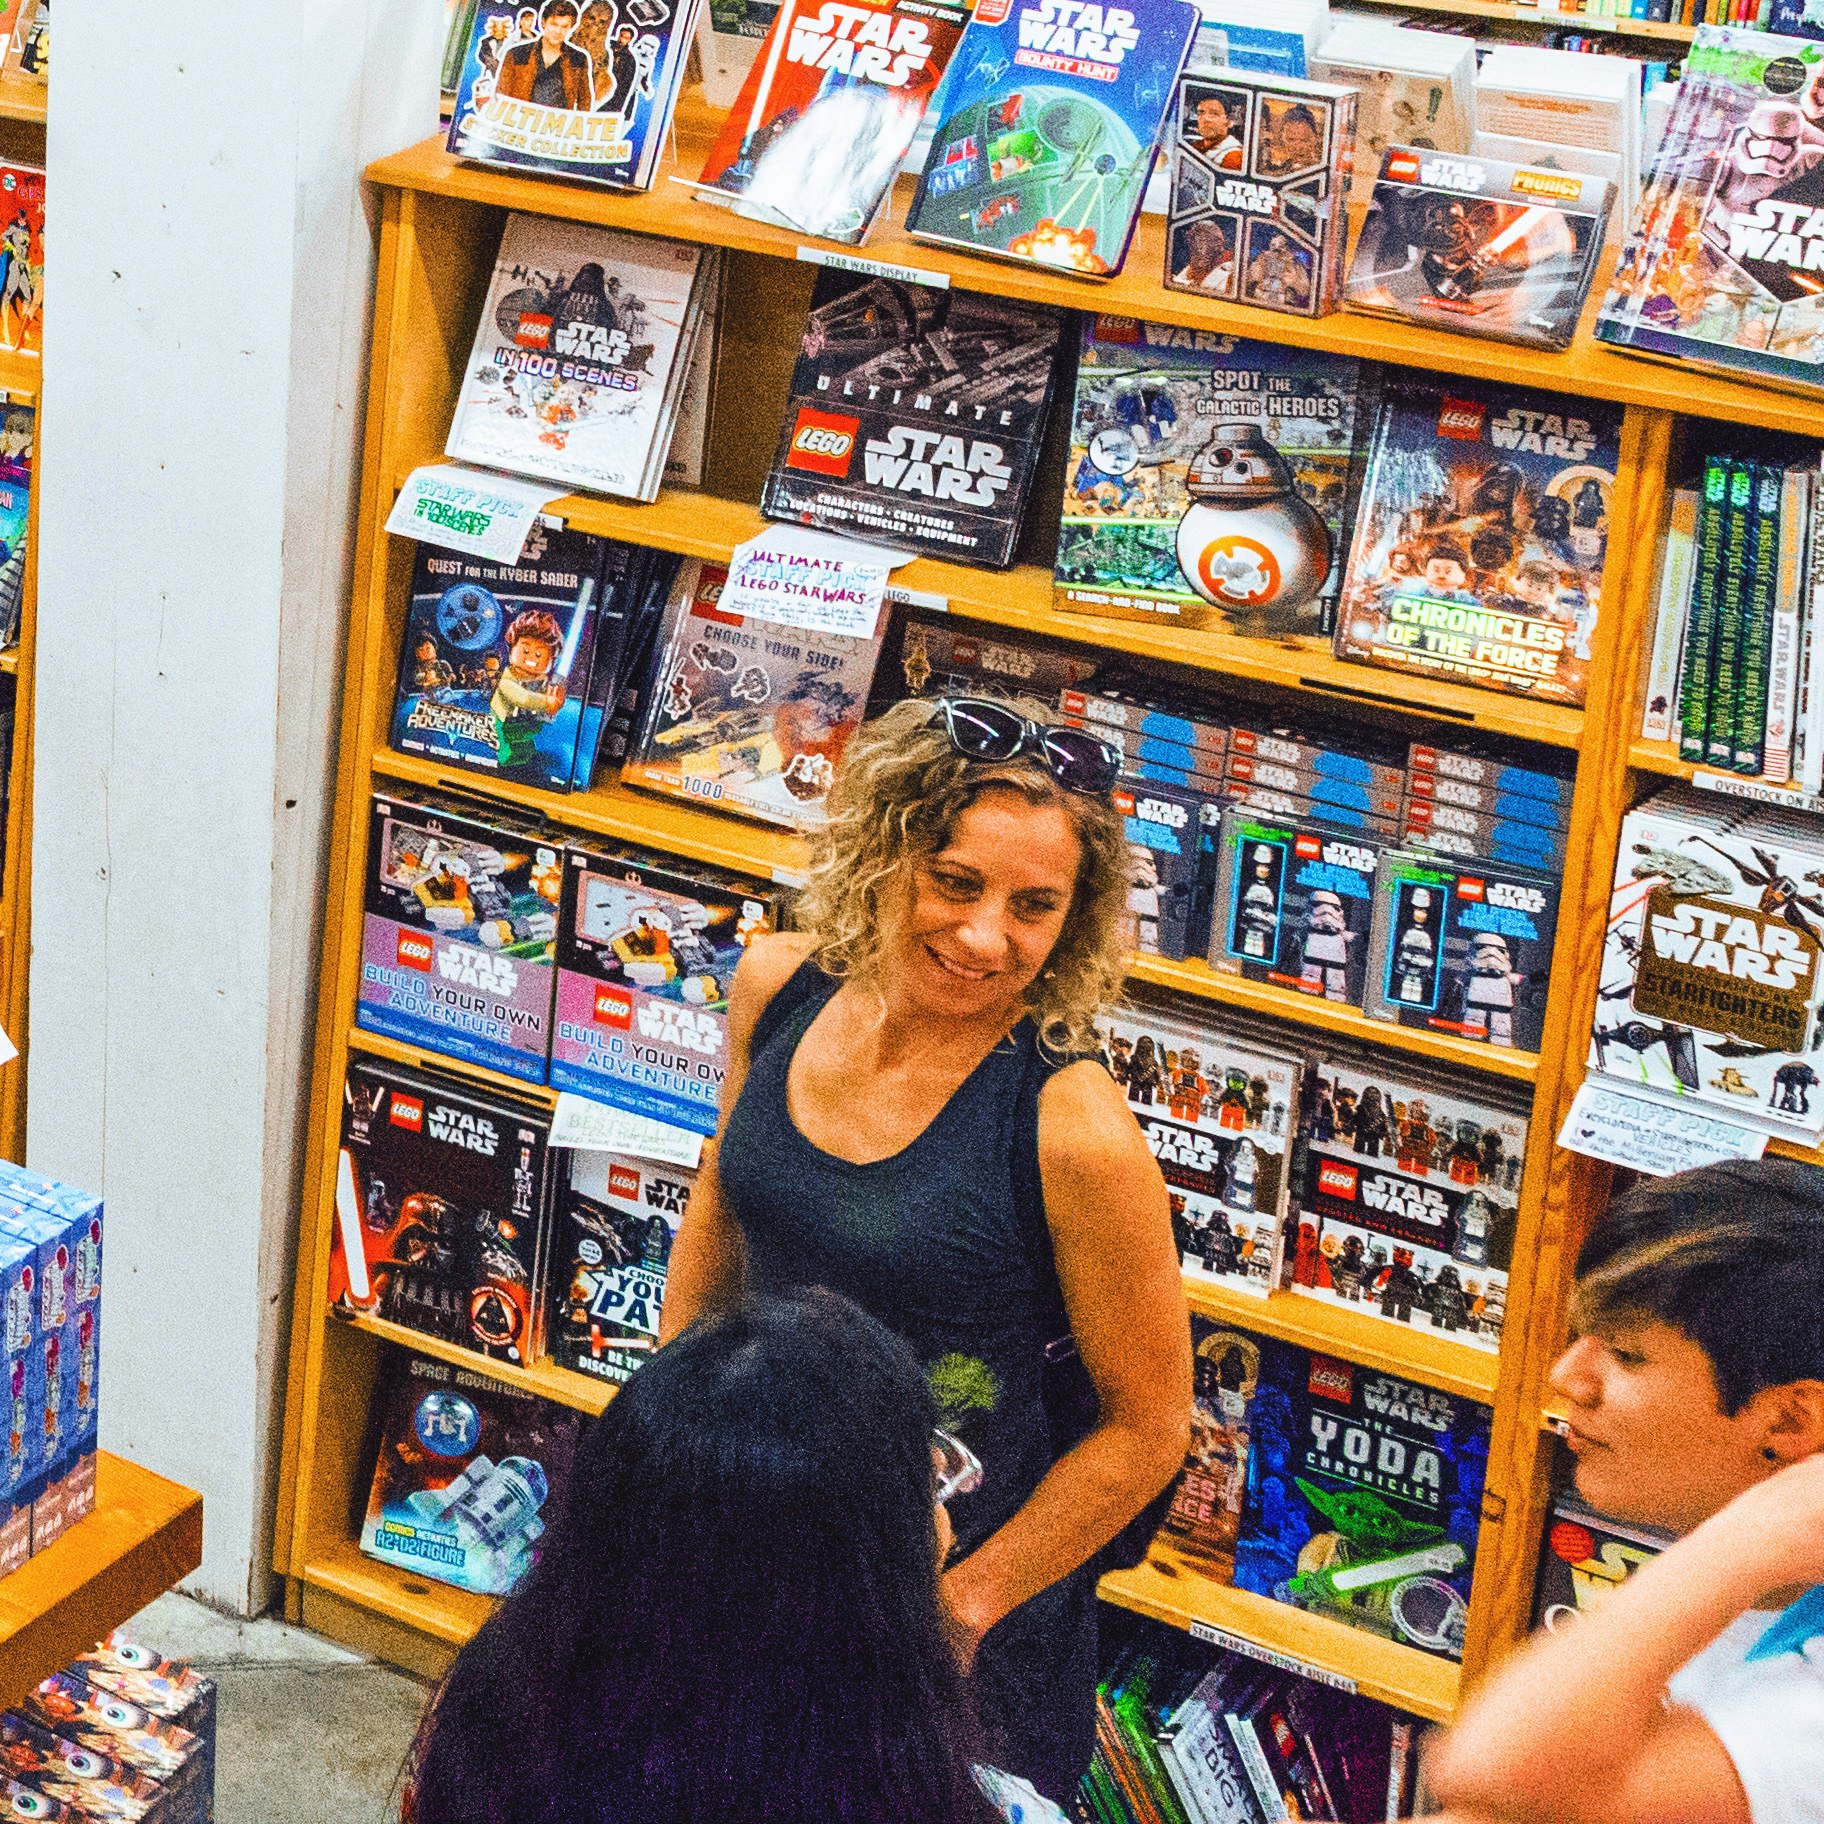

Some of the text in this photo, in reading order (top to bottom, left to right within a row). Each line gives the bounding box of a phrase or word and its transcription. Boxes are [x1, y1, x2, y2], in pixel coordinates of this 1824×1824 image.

[798, 2, 933, 59] STAR
[1017, 19, 1137, 64] WARS
[787, 30, 928, 88] WARS
[1017, 51, 1117, 81] BOUNTY HUNT
[485, 97, 619, 142] ULTIMATE
[1512, 172, 1580, 199] PHONICS
[824, 253, 919, 282] STAR WARS DISPLAY
[494, 349, 639, 392] IN 100 SCENES
[1212, 369, 1292, 393] SPOT THE
[816, 375, 1014, 426] ULTIMATE
[1197, 395, 1340, 419] GALACTIC HEROES
[1386, 621, 1558, 676] OF THE FORCE
[1391, 598, 1565, 653] CHRONICLES
[682, 776, 724, 799] 1000
[1714, 779, 1777, 800] OVERSTOCK
[364, 964, 541, 1033] BUILD YOUR OWN
[389, 991, 512, 1043] ADVENTURE
[586, 1050, 718, 1102] ADVENTURE
[1309, 1414, 1443, 1490] YODA
[1305, 1450, 1440, 1506] CHRONICLES
